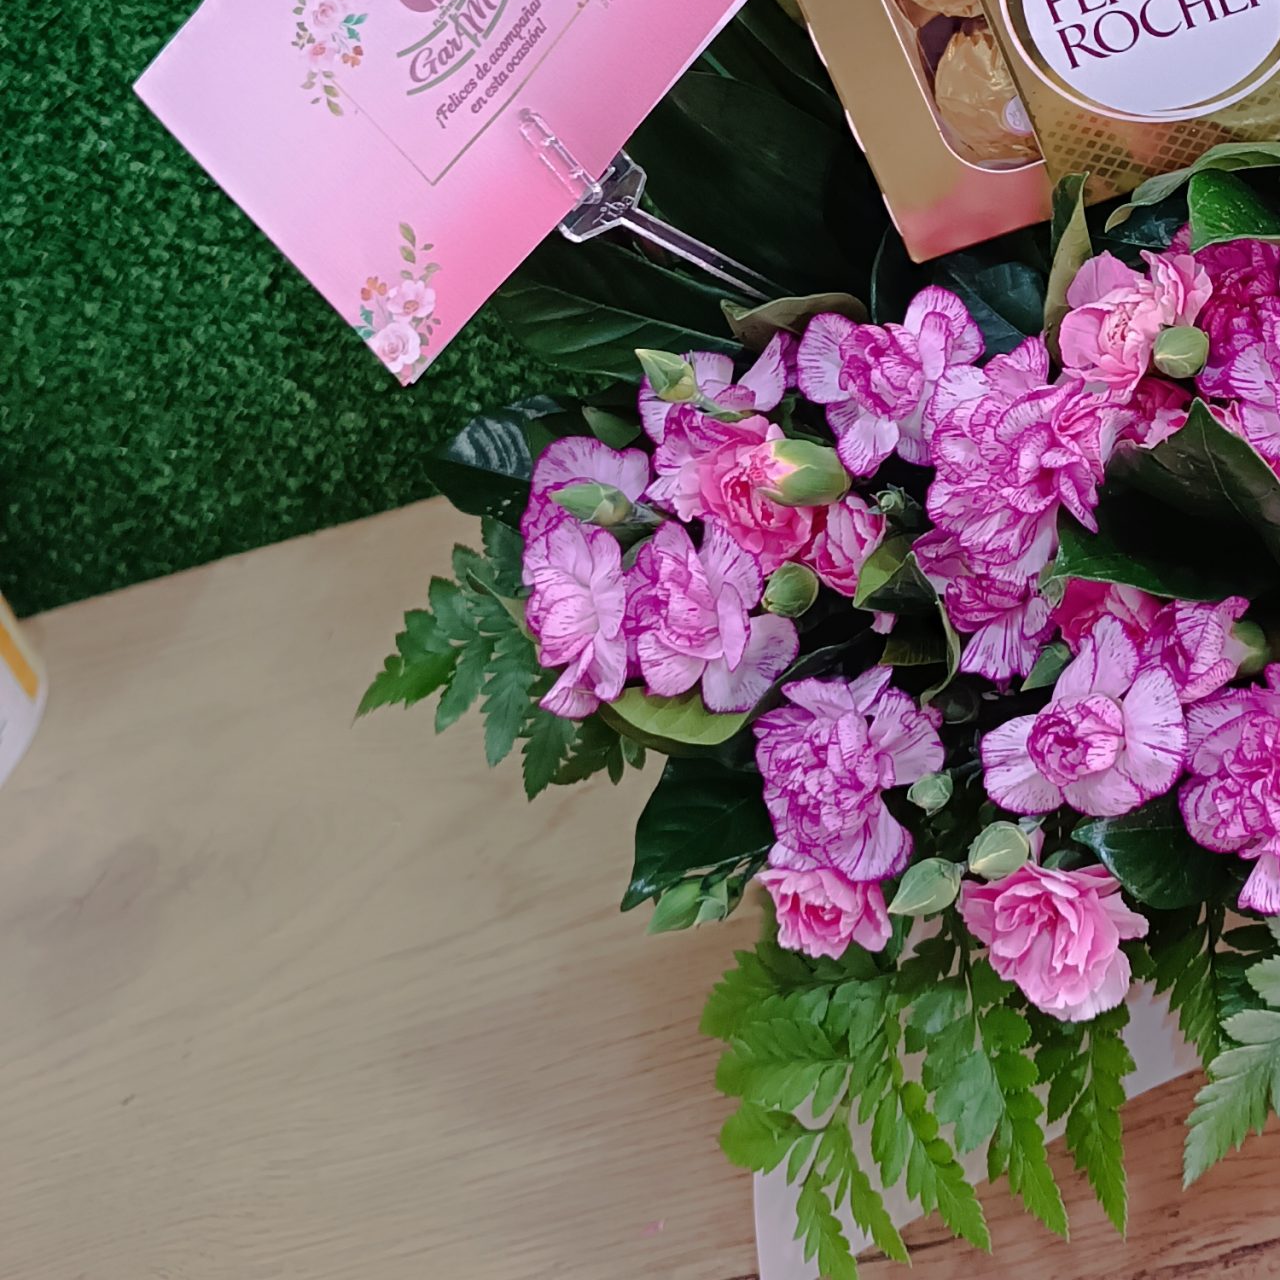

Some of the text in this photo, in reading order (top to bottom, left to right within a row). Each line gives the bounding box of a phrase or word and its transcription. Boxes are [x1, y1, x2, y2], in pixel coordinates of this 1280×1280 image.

[436, 78, 478, 130] ¡Felices
[475, 63, 492, 81] de
[470, 17, 548, 114] en esta ocasión!
